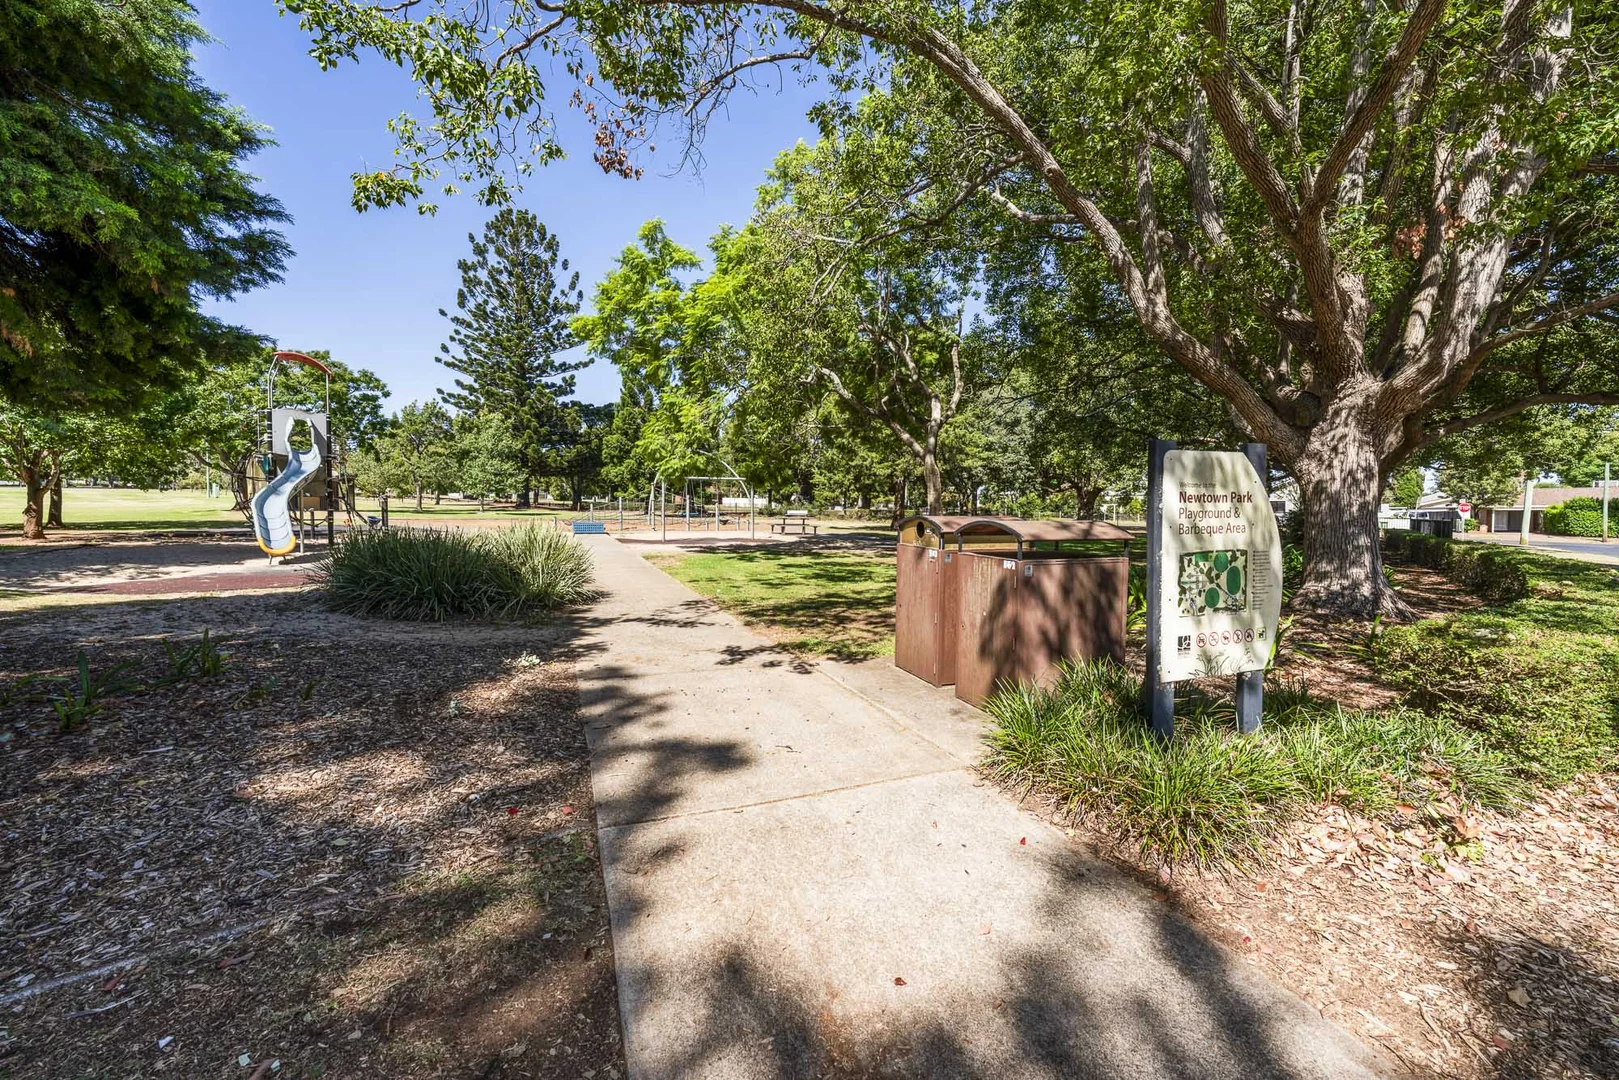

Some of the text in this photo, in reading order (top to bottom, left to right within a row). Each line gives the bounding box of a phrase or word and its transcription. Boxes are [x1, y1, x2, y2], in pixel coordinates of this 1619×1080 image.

[1179, 491, 1253, 503] Newtown Park
[1179, 506, 1241, 522] Playground &
[1179, 523, 1246, 537] Barbeque Area
